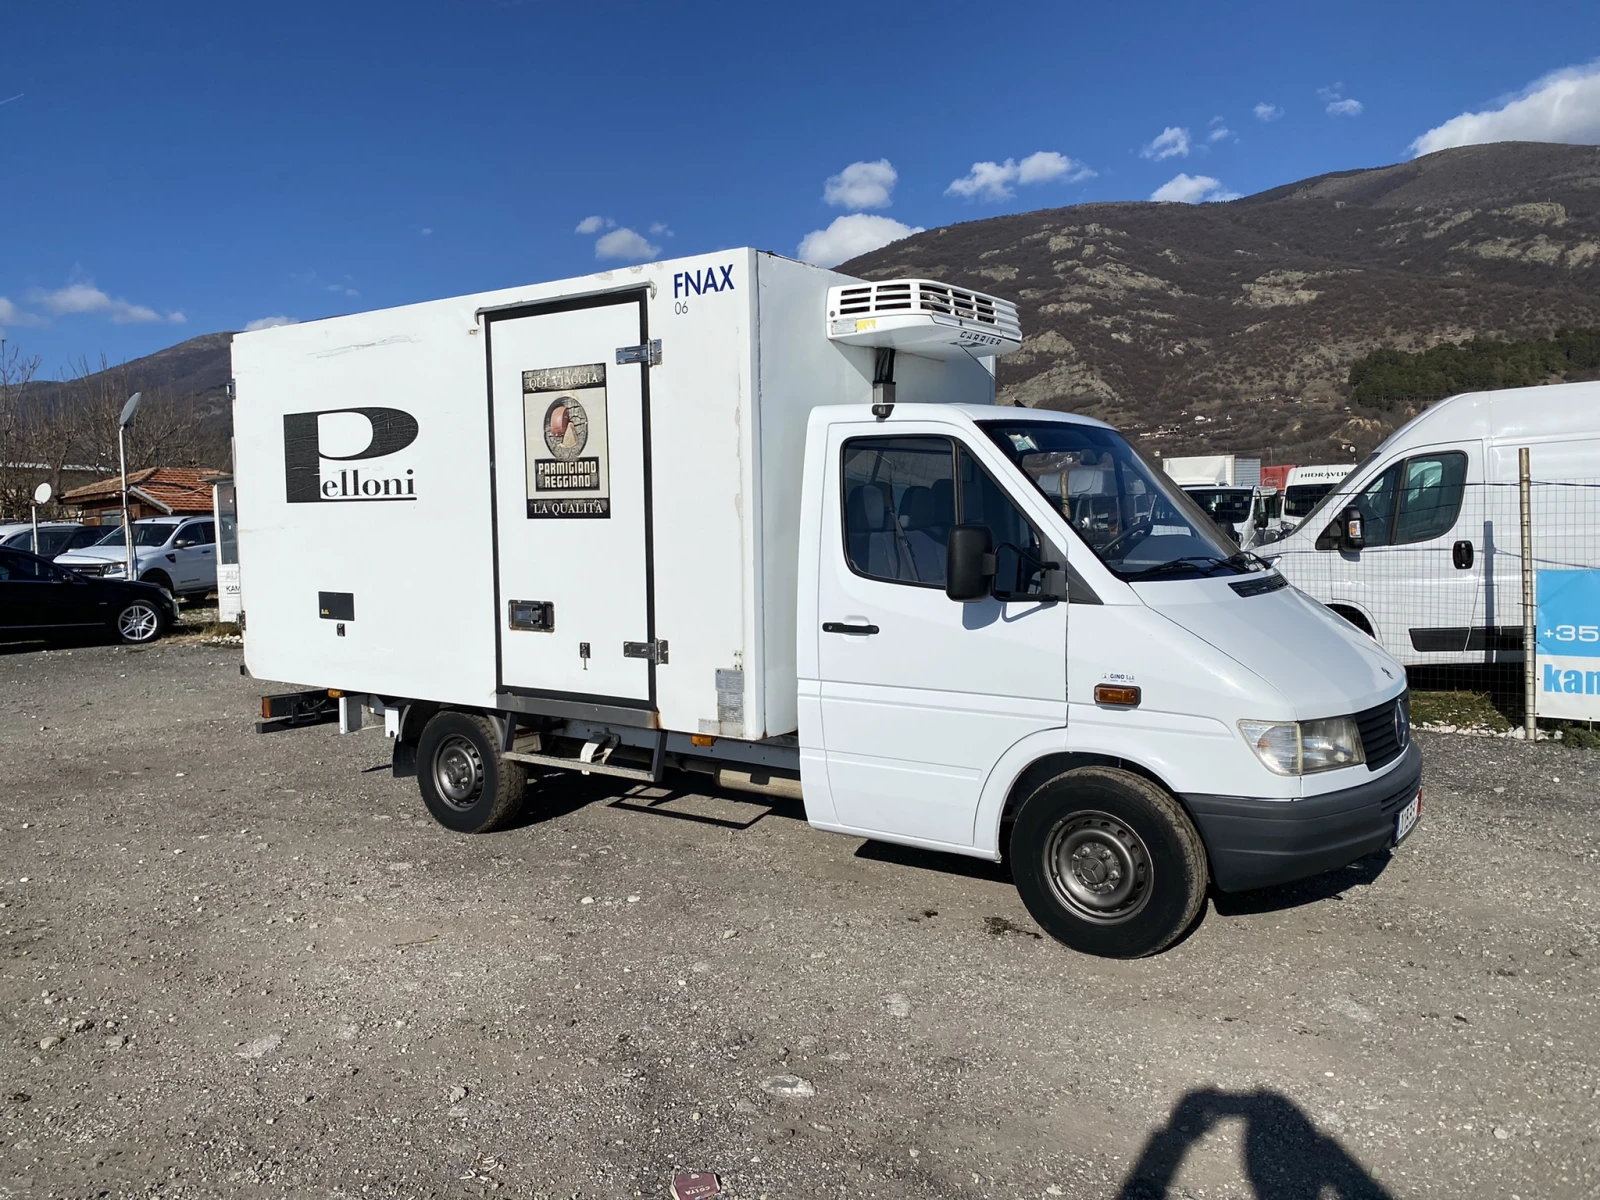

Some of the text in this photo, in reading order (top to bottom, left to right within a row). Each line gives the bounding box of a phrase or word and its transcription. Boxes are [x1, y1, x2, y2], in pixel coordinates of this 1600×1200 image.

[673, 263, 735, 299] FNAX
[674, 302, 689, 316] 06
[960, 331, 1002, 346] CARRIER
[283, 407, 419, 503] Pelloni
[538, 461, 597, 475] PARMIGIANO
[544, 474, 591, 488] REGGIANO
[533, 503, 549, 514] LA
[1544, 625, 1600, 642] +35
